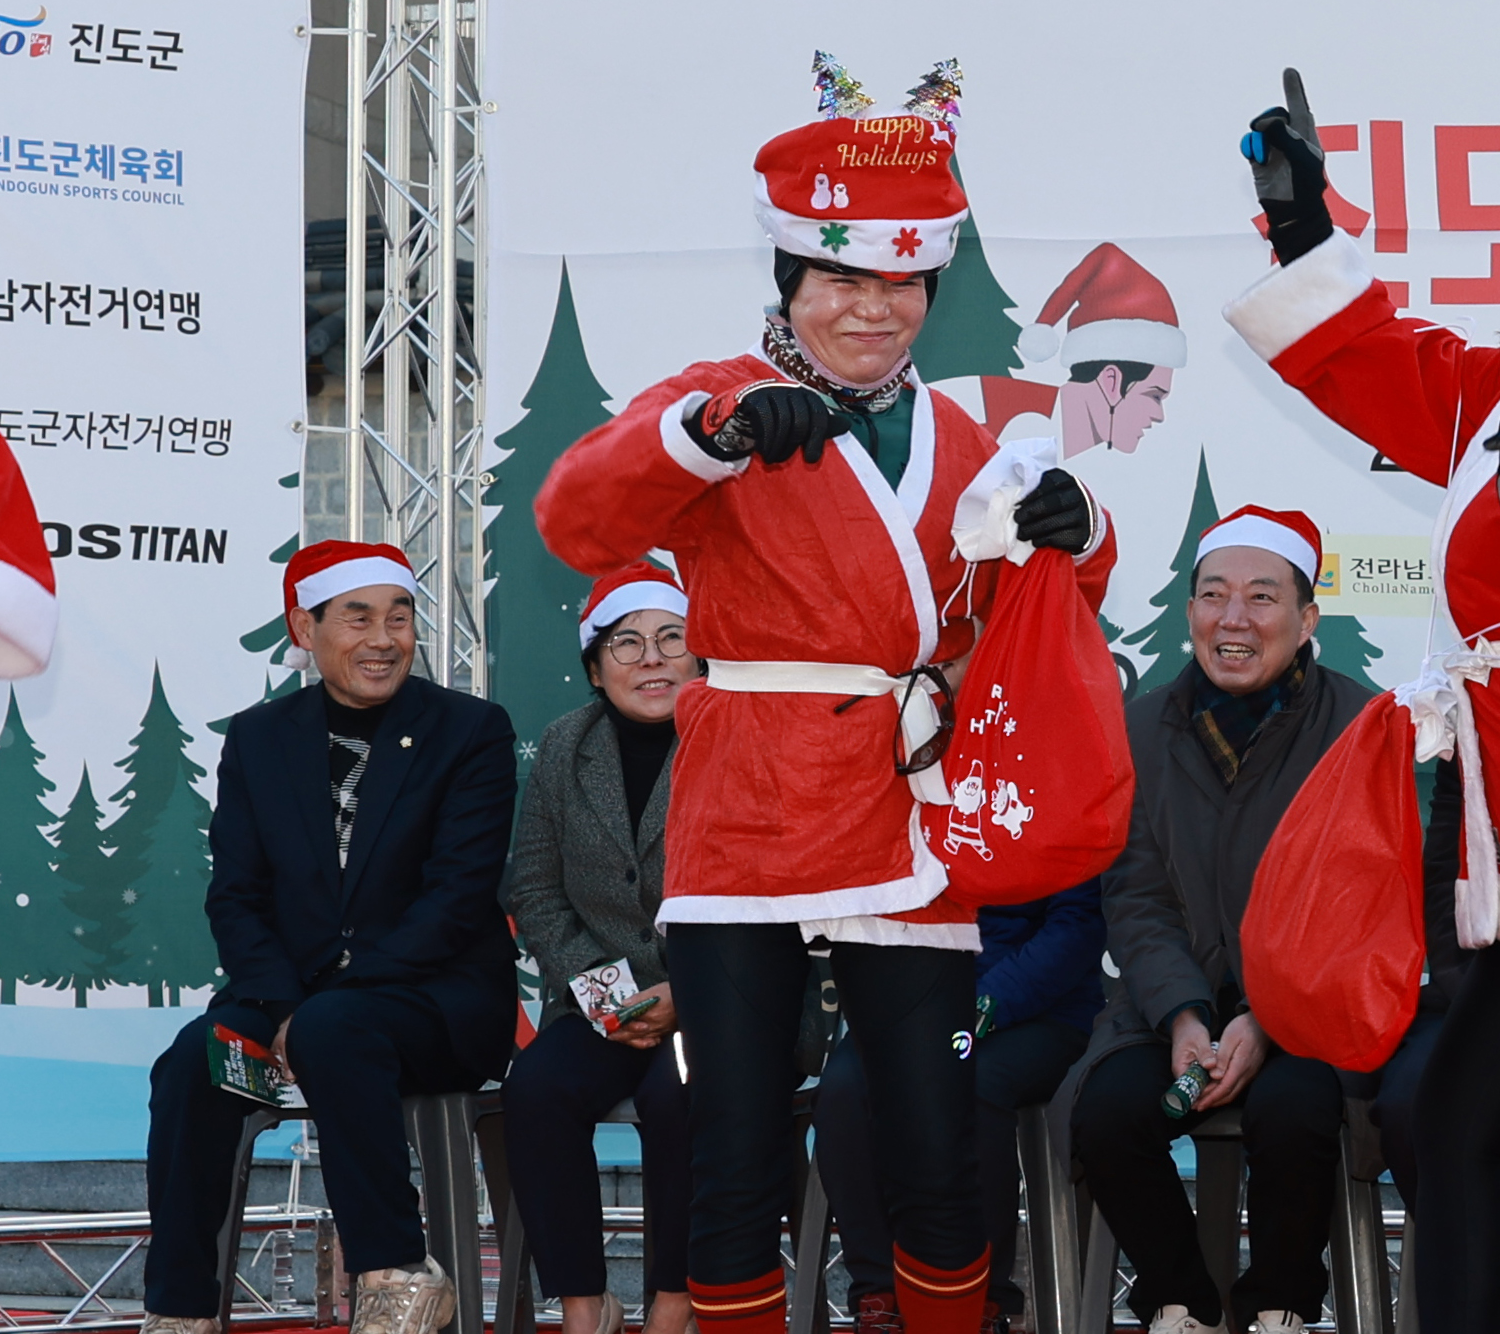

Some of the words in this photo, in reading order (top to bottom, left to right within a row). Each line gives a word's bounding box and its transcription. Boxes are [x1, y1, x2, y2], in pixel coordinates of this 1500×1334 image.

[68, 23, 184, 71] 진도군
[837, 143, 938, 174] Holidays
[63, 185, 118, 201] SPORTS
[122, 190, 185, 205] COUNCIL
[129, 524, 228, 564] TITAN
[1350, 557, 1432, 581] 전라남
